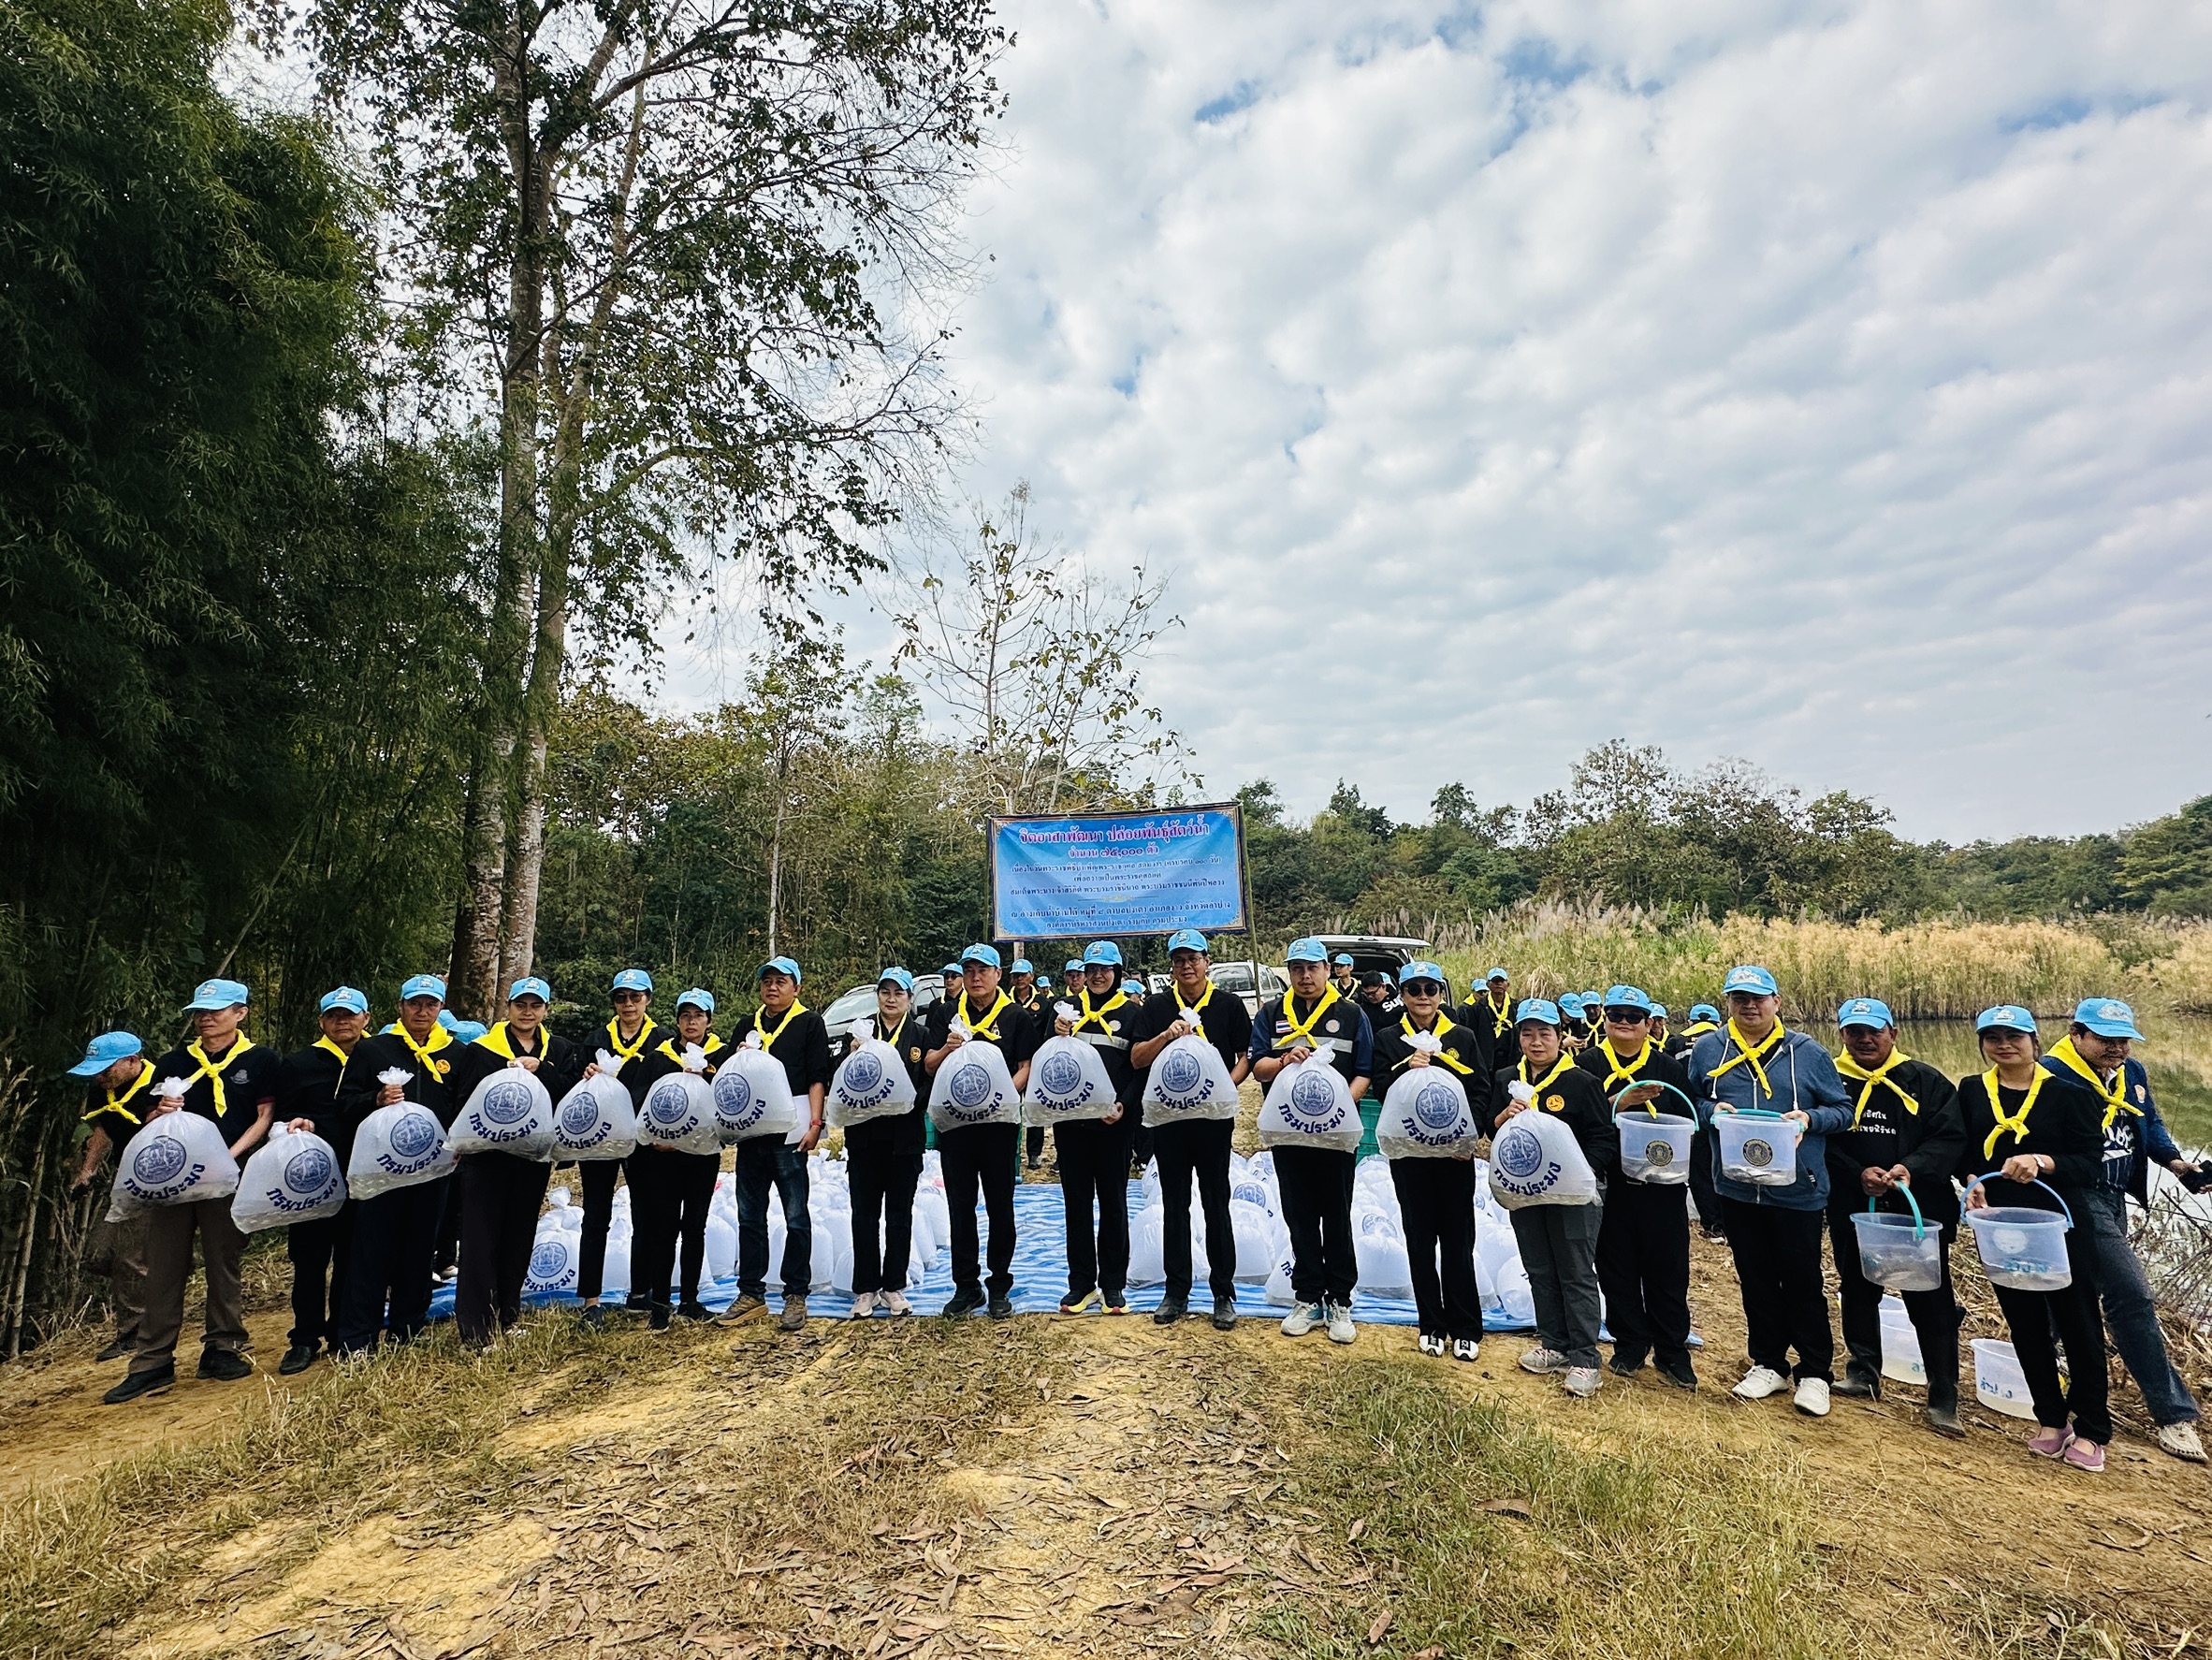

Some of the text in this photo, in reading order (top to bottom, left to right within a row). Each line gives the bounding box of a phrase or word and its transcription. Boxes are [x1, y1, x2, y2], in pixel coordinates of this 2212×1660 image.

[1019, 814, 1210, 844] จิตอาสาพัฒนา ปล่อยพันธุ์สัตว์น้ำ
[1068, 845, 1099, 858] จำนวน
[1145, 841, 1159, 854] ตัว
[837, 1078, 895, 1109] กรมประมง
[942, 1091, 1003, 1122] กรมประมง
[1034, 1081, 1094, 1111] กรมประมง
[1154, 1078, 1215, 1110] กรมประมง
[469, 1112, 538, 1143] กรมประมง
[643, 1111, 699, 1140] กรมประมง
[714, 1099, 766, 1131] กรมประมง
[1278, 1103, 1346, 1134] กรมประมง
[555, 1121, 612, 1149] กรมประมง
[1402, 1116, 1468, 1146] กรมประมง
[376, 1139, 444, 1174] กรมประมง
[124, 1163, 205, 1200] กรมประมง
[266, 1177, 338, 1211] กรมประมง
[1494, 1161, 1562, 1196] กรมประมง
[523, 1268, 575, 1291] รมประมง
